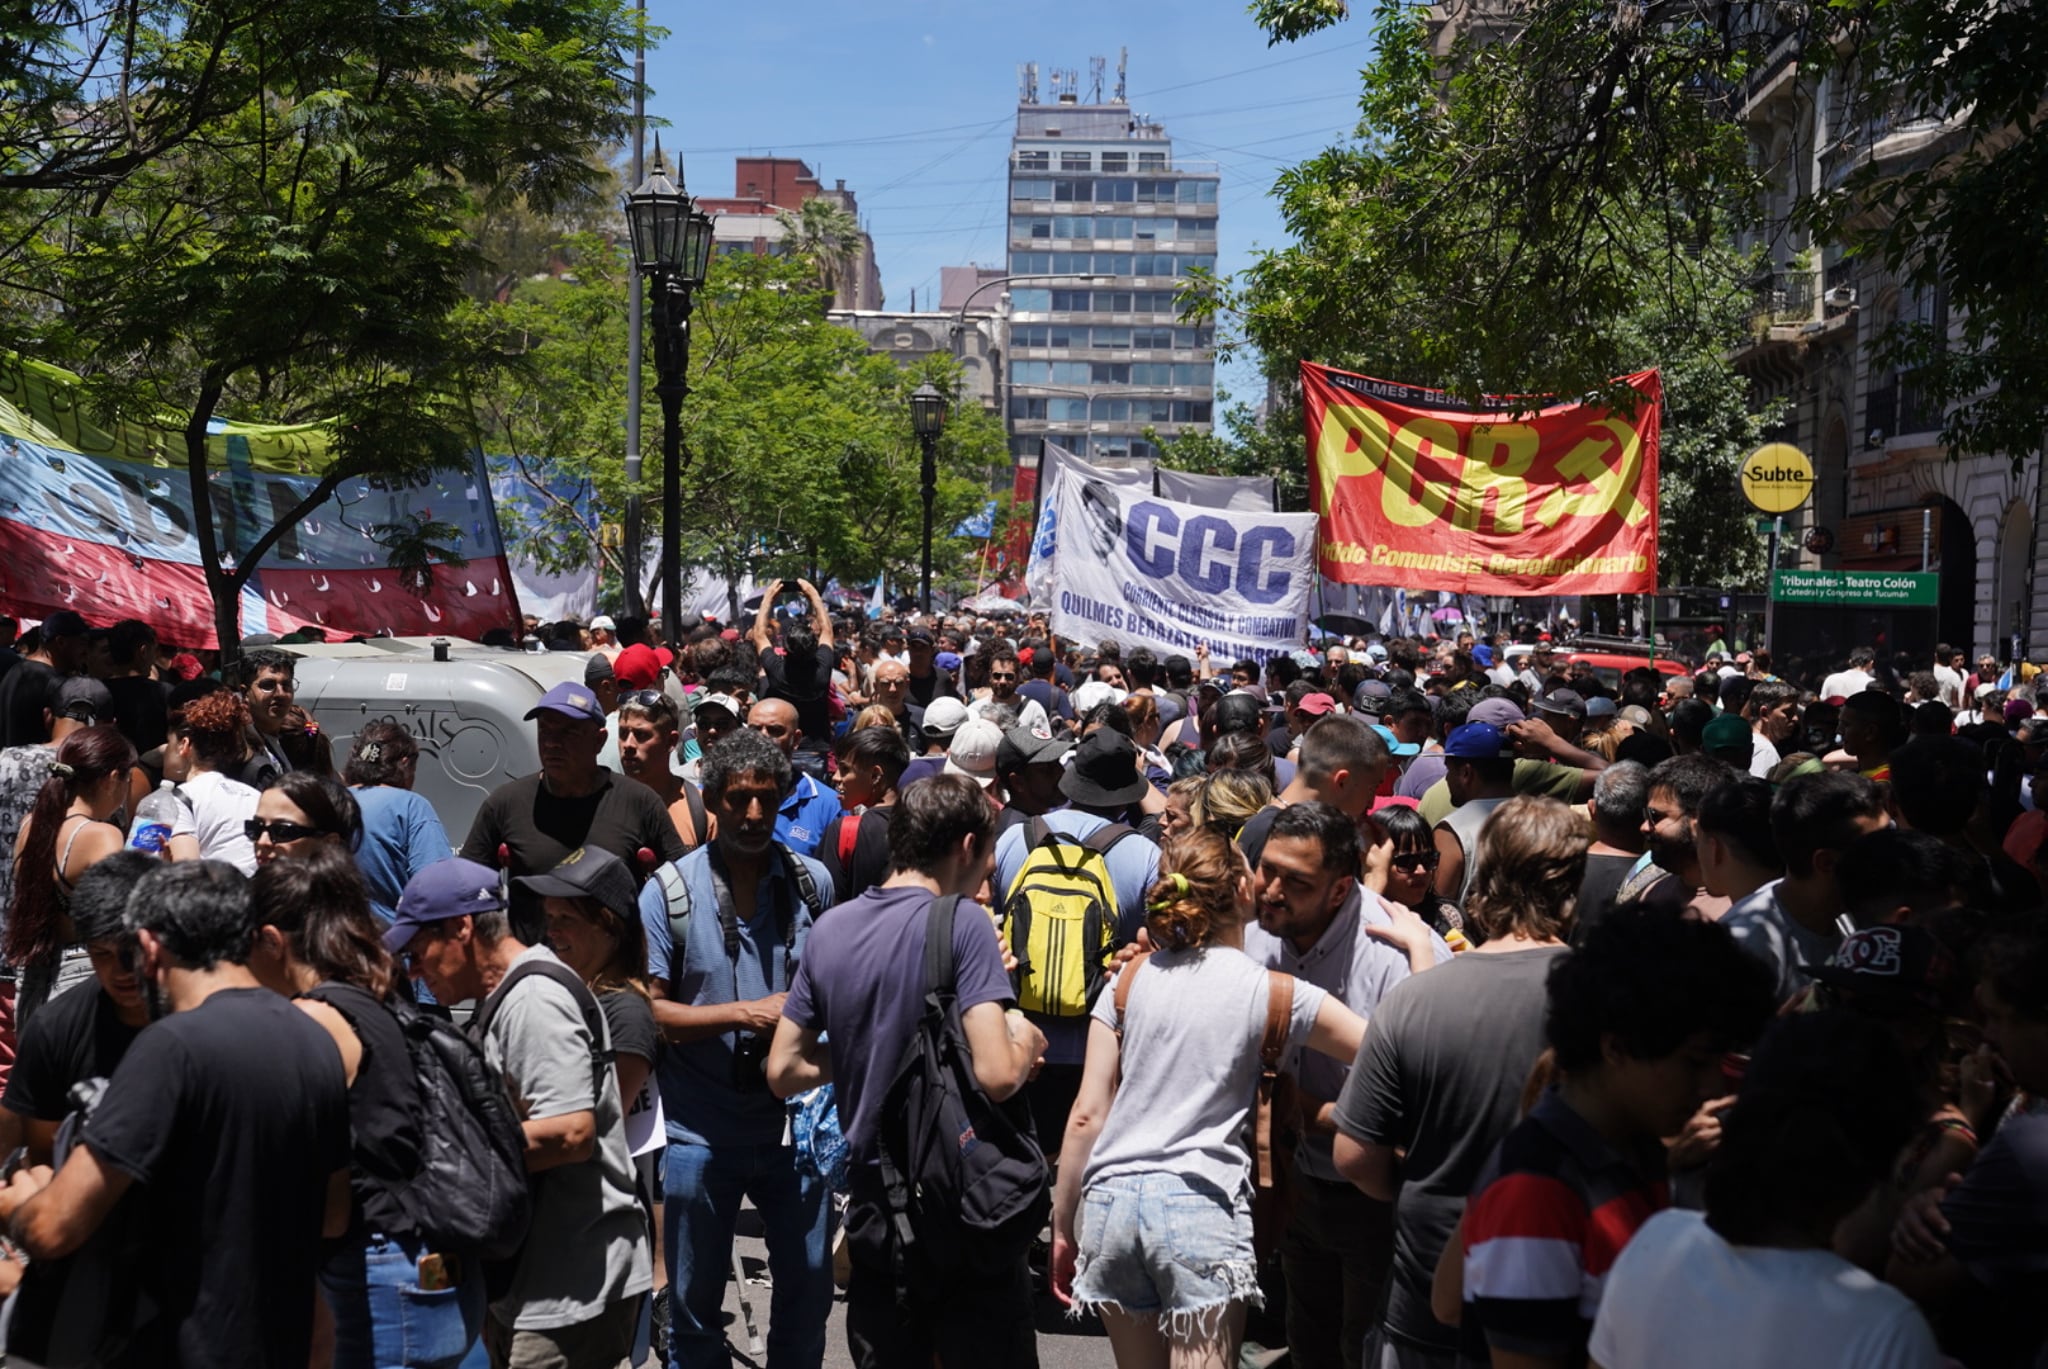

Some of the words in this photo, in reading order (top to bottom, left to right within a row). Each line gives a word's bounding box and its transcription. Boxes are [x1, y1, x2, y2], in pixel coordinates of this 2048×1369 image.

[1335, 375, 1409, 400] QUILMES
[1317, 402, 1540, 533] PCR
[1751, 466, 1804, 482] Subte
[1126, 500, 1295, 605] CCC
[1371, 544, 1482, 575] Comunista
[1489, 551, 1647, 577] Revolucionario
[1780, 575, 1837, 587] Tribunales
[1846, 577, 1881, 588] Teatro
[1883, 576, 1916, 589] Colón
[1786, 588, 1818, 597] Catedral
[1819, 590, 1825, 598] y
[1826, 589, 1861, 599] Congreso
[1863, 589, 1873, 598] de
[1874, 589, 1909, 598] Tucumán
[1061, 591, 1123, 629] QUILMES
[1123, 581, 1176, 618] CORRIENTE
[1177, 603, 1226, 632] CLASISTA
[1238, 614, 1297, 639] COMBATIVA
